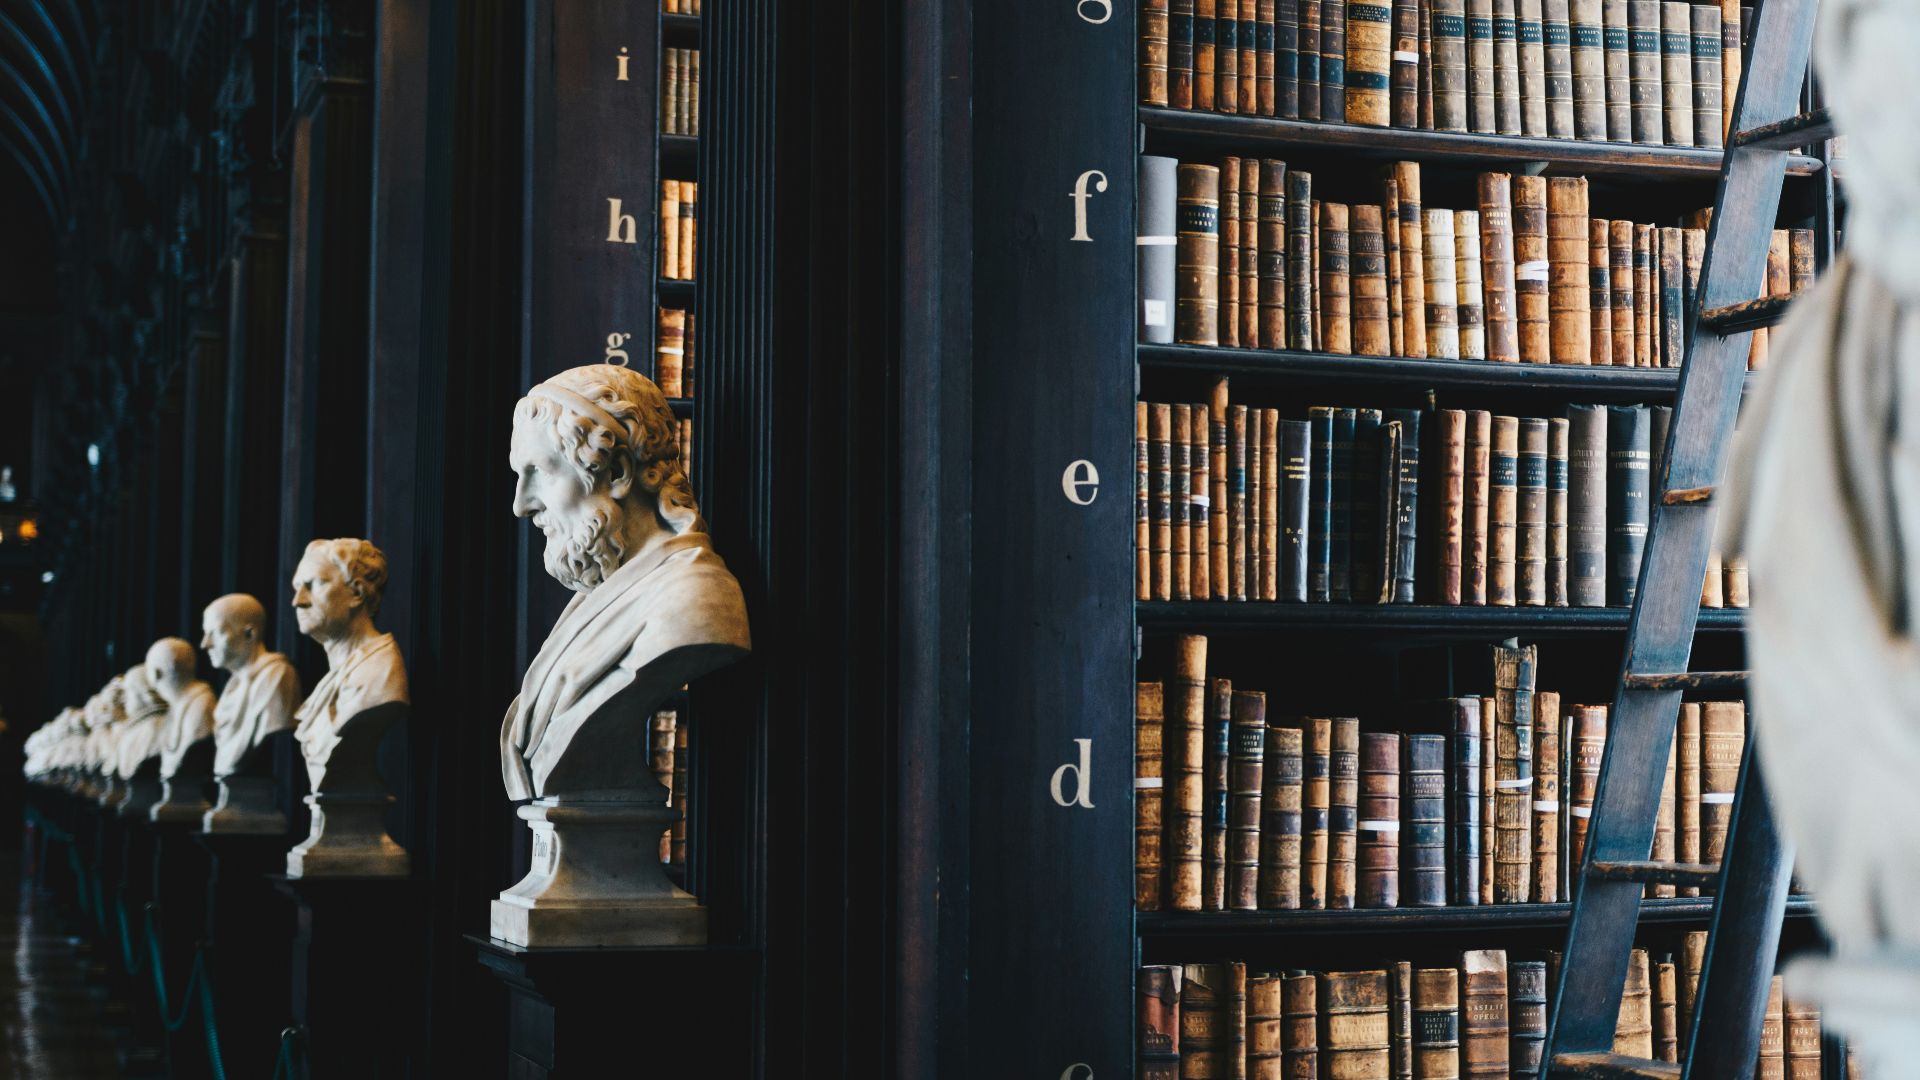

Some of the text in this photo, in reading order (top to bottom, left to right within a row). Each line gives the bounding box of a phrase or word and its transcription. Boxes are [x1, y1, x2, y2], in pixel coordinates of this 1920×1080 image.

[616, 46, 631, 81] i
[606, 197, 638, 244] h
[1068, 169, 1108, 241] f
[605, 332, 631, 367] g
[1062, 459, 1100, 506] e
[1050, 738, 1096, 808] d
[1577, 757, 1600, 765] BIBL
[1473, 1012, 1500, 1020] OPERA
